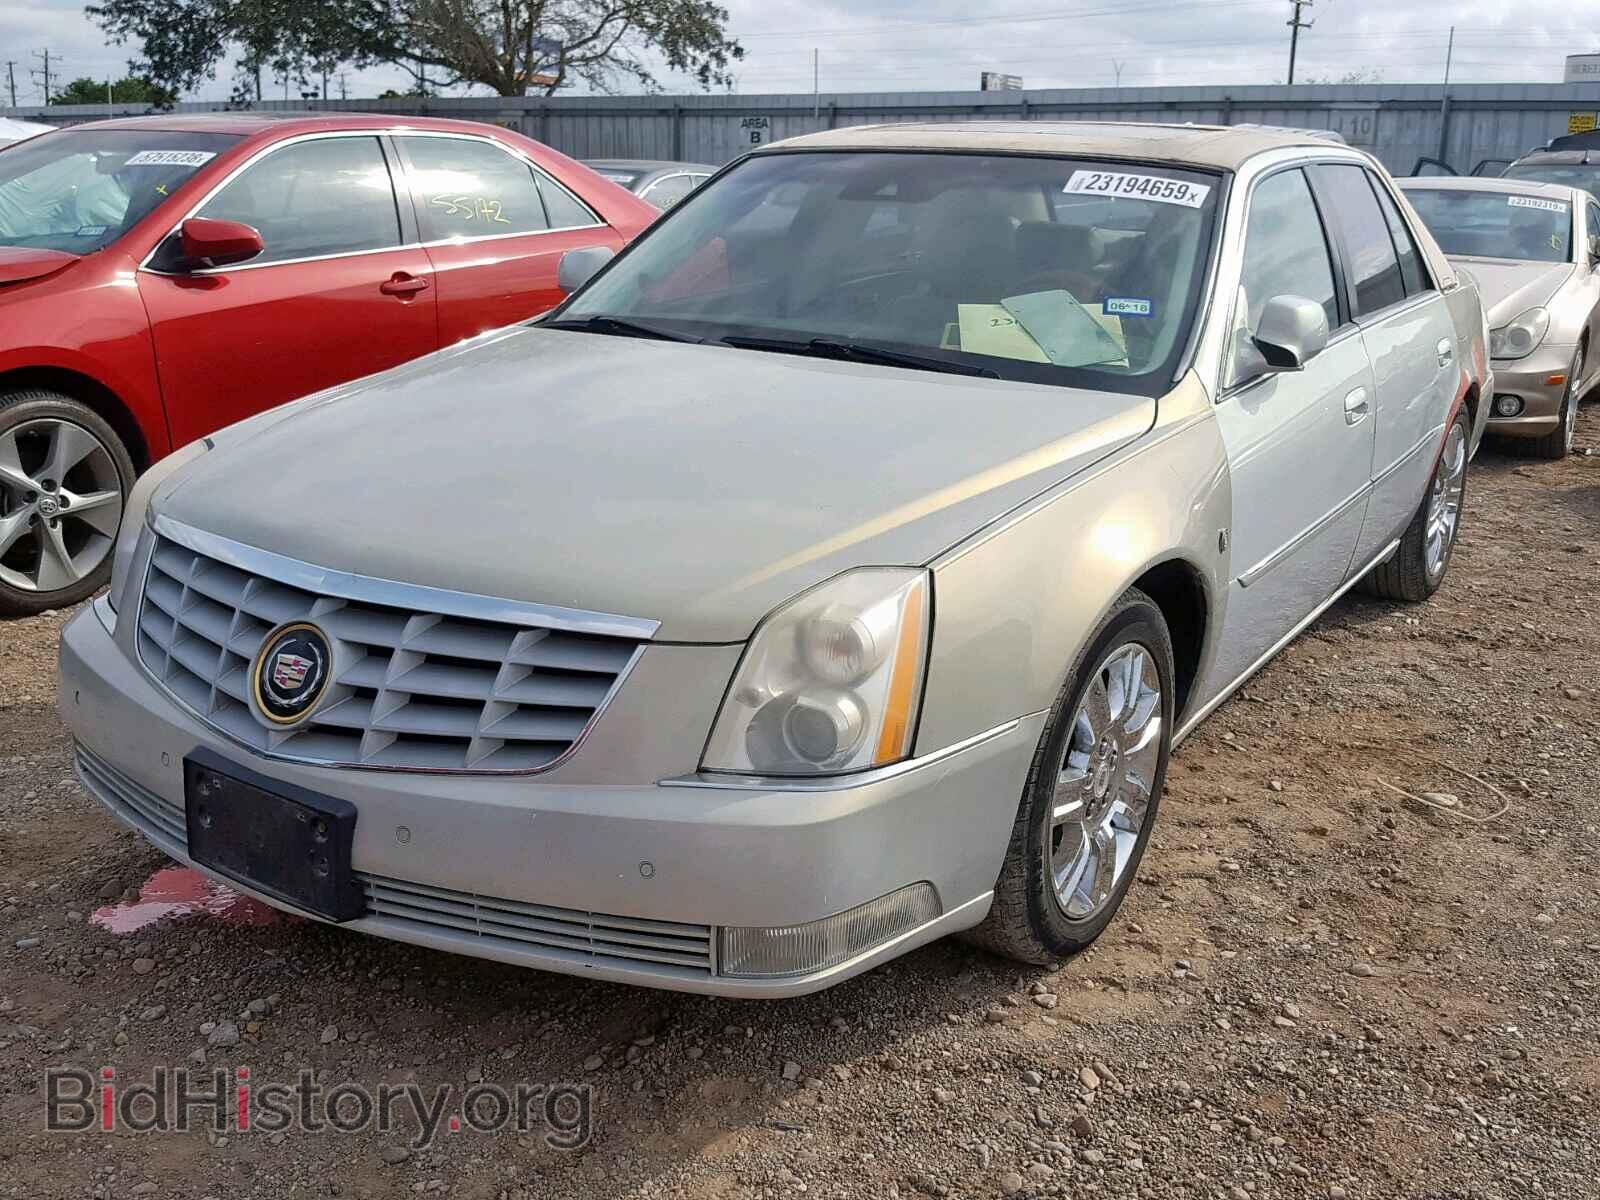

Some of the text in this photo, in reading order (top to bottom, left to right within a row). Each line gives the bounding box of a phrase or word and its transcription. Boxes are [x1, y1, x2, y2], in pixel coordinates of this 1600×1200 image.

[740, 118, 769, 128] AREA
[1350, 116, 1371, 135] 10
[751, 131, 761, 144] B
